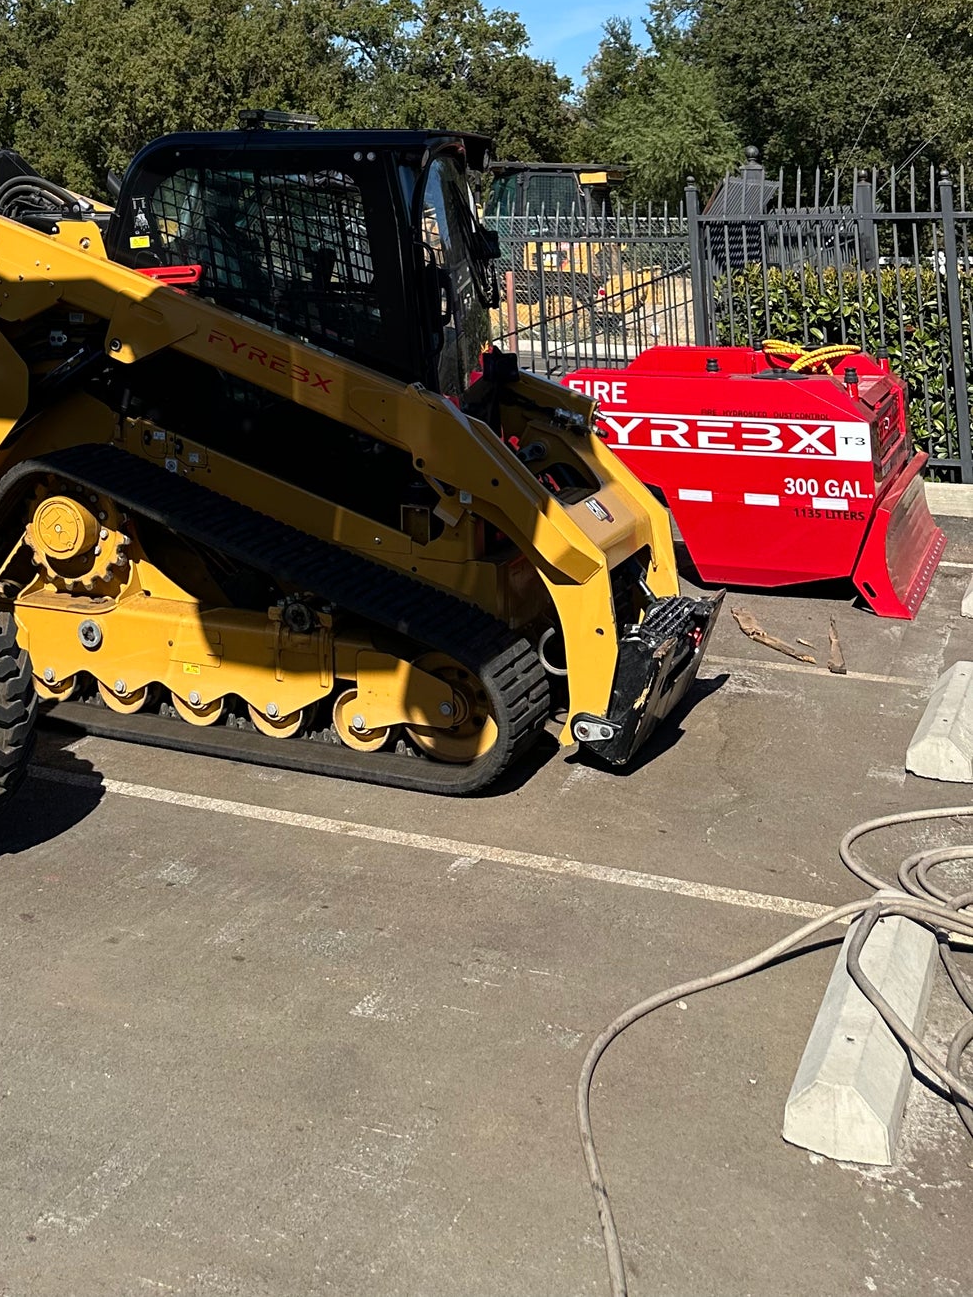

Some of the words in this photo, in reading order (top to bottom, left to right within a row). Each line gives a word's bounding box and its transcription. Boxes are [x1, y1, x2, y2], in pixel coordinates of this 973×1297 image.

[700, 408, 717, 417] FIRE
[773, 411, 793, 420] DUST
[794, 412, 830, 421] CONTROL
[839, 435, 866, 446] T3
[784, 477, 819, 496] 300
[824, 479, 874, 499] GAL.
[793, 507, 822, 519] 1135
[826, 508, 866, 521] LITERS
